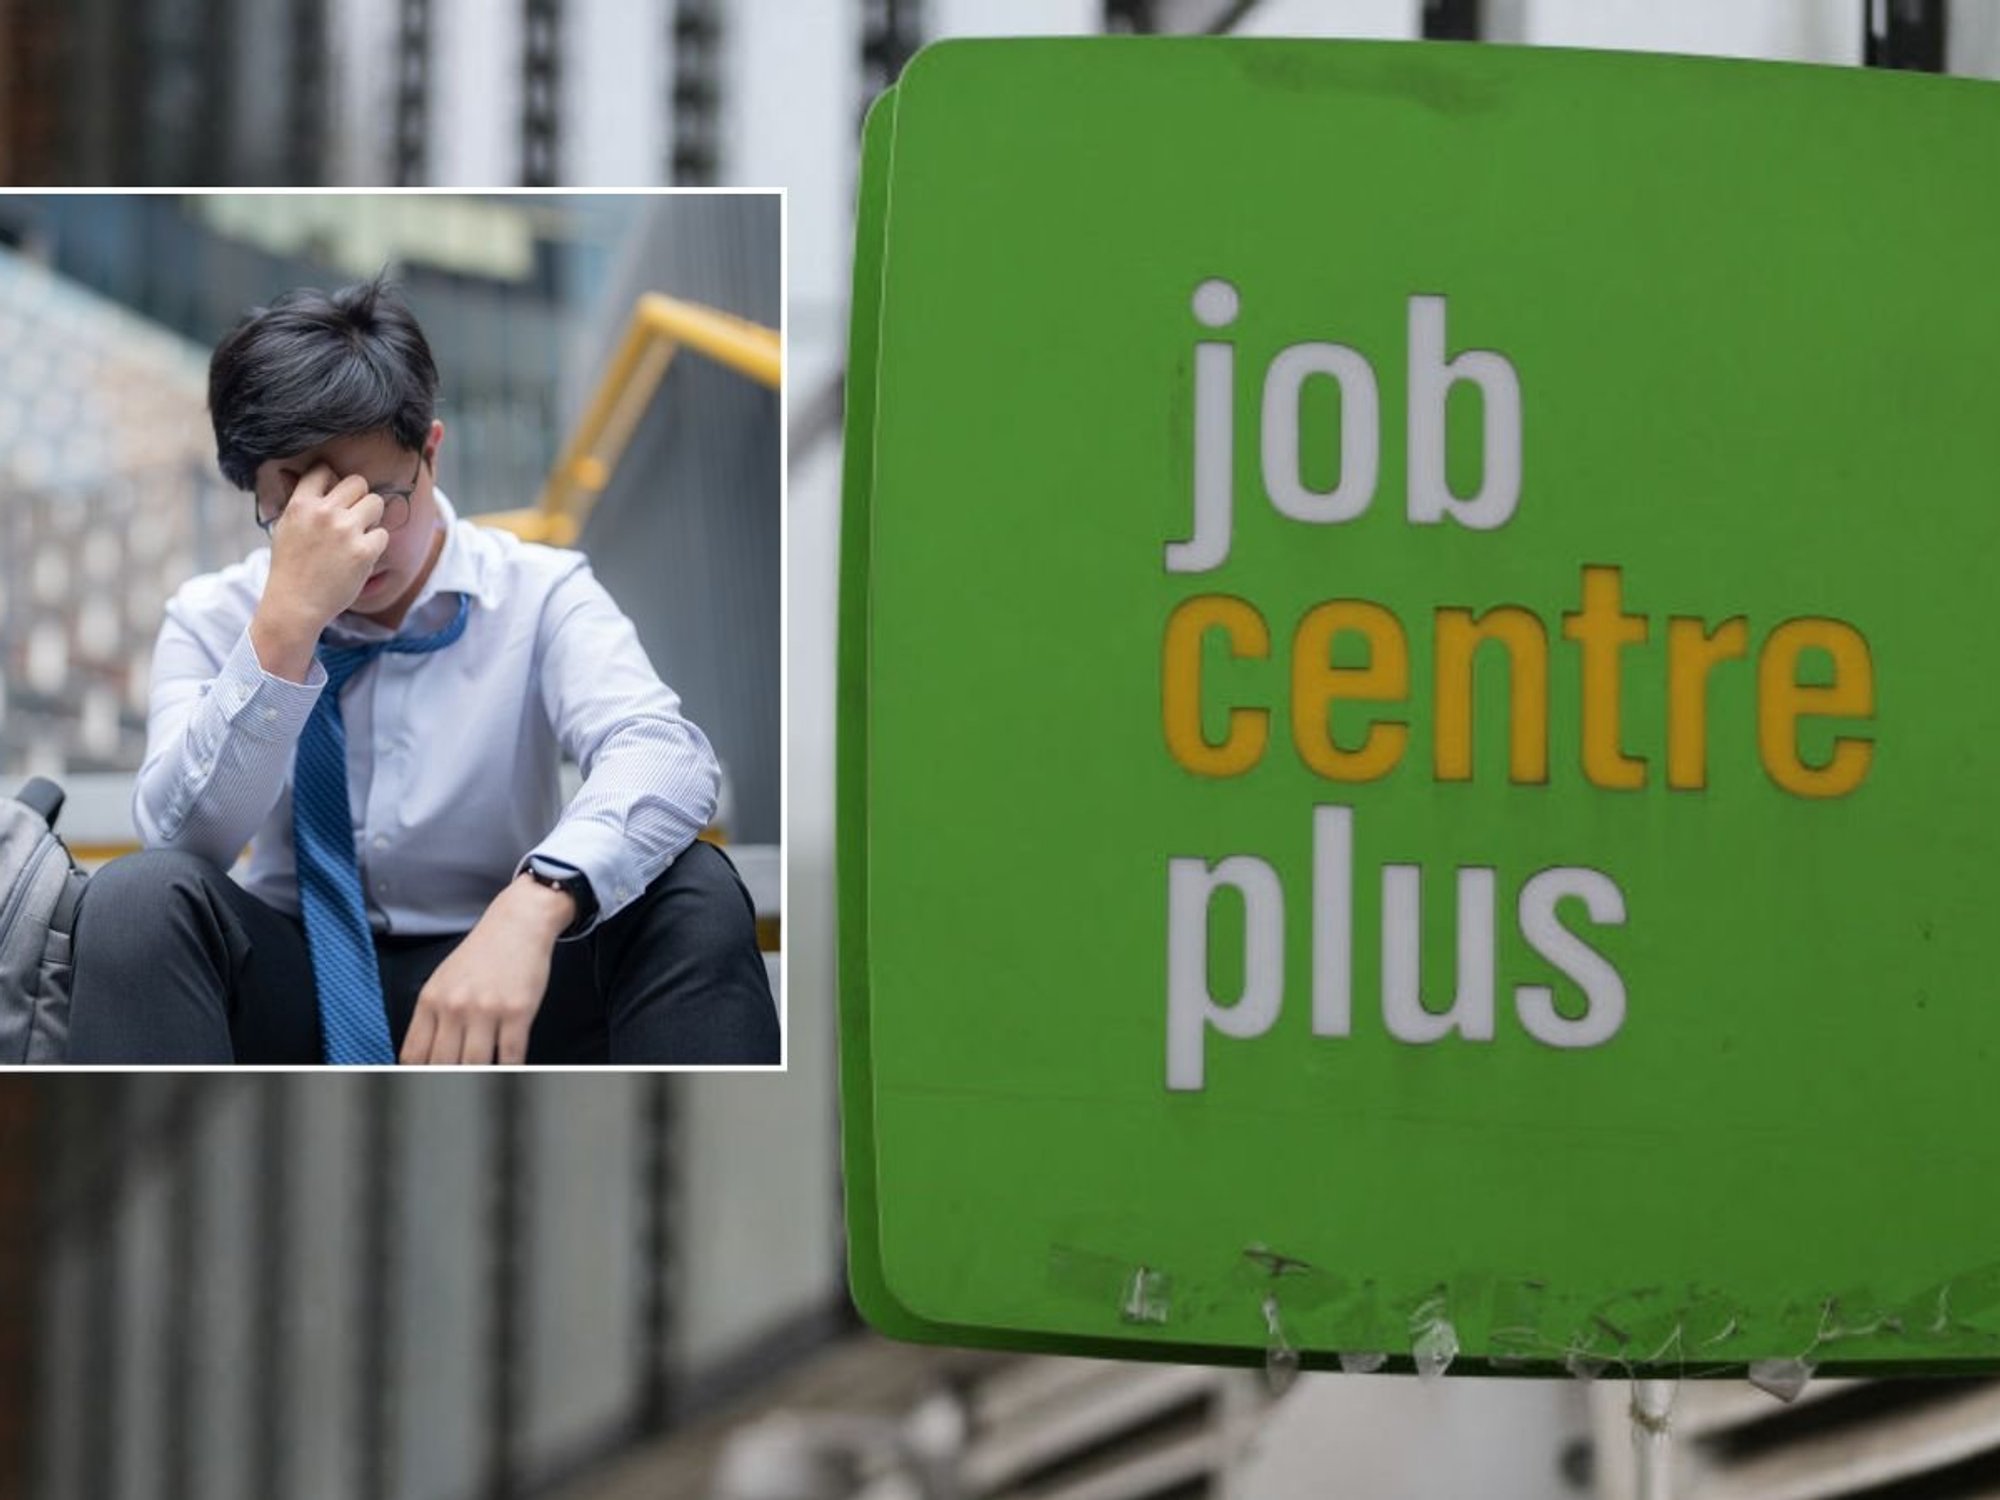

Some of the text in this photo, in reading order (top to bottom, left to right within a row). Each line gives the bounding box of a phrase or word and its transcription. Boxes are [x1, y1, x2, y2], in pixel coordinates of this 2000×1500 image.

[1165, 279, 1523, 572] job
[1162, 566, 1876, 798] centre
[1166, 805, 1628, 1091] plus
